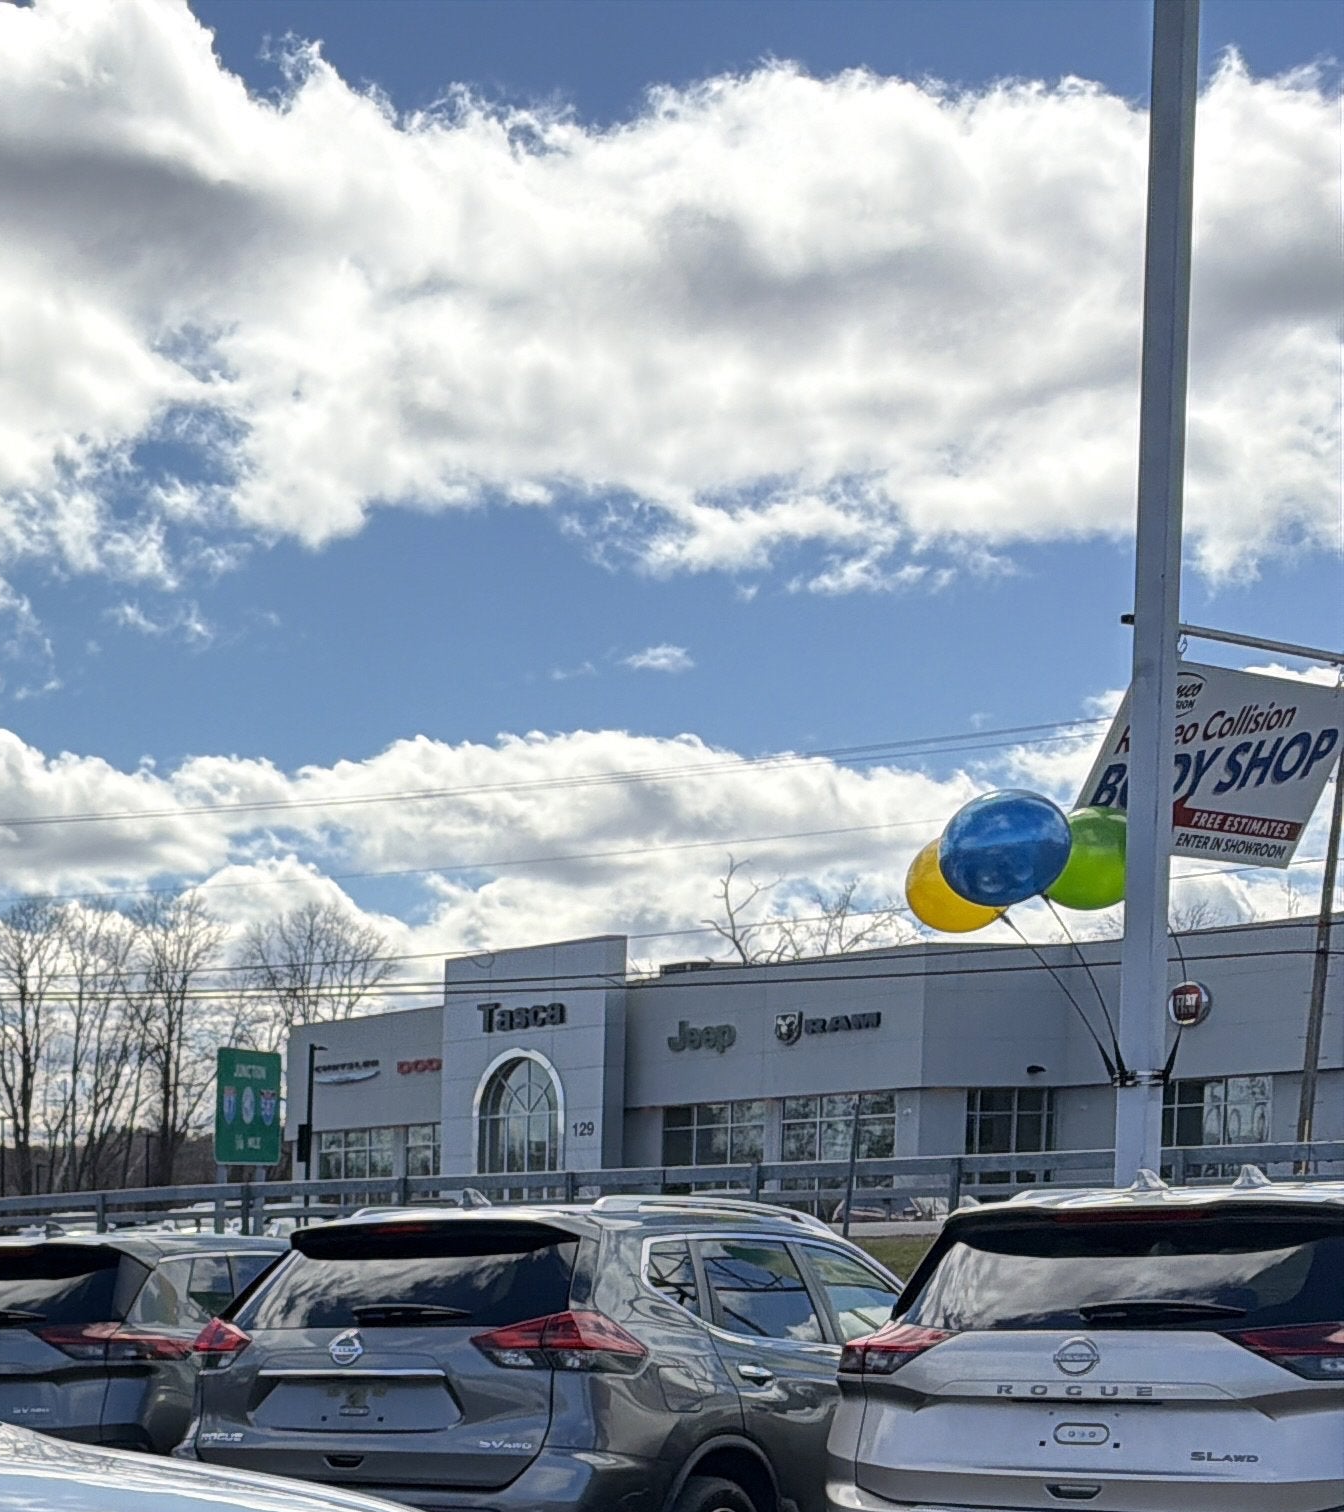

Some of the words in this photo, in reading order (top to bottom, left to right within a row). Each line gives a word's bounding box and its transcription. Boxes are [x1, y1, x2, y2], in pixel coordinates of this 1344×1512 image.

[1202, 701, 1297, 742] Collision
[1212, 728, 1339, 796] SHOP
[1190, 811, 1224, 830] FREE
[1223, 816, 1291, 838] ESTIMATES
[1175, 832, 1211, 850] ENTER
[1209, 837, 1225, 852] IN
[1221, 840, 1287, 859] SHOWROOM
[476, 1002, 567, 1034] Tasca
[805, 1011, 882, 1035] RAM
[667, 1020, 737, 1053] Jeep
[572, 1121, 595, 1137] 129
[997, 1384, 1153, 1397] ROGUE
[1191, 1451, 1224, 1462] SL
[1223, 1454, 1259, 1463] AWD
